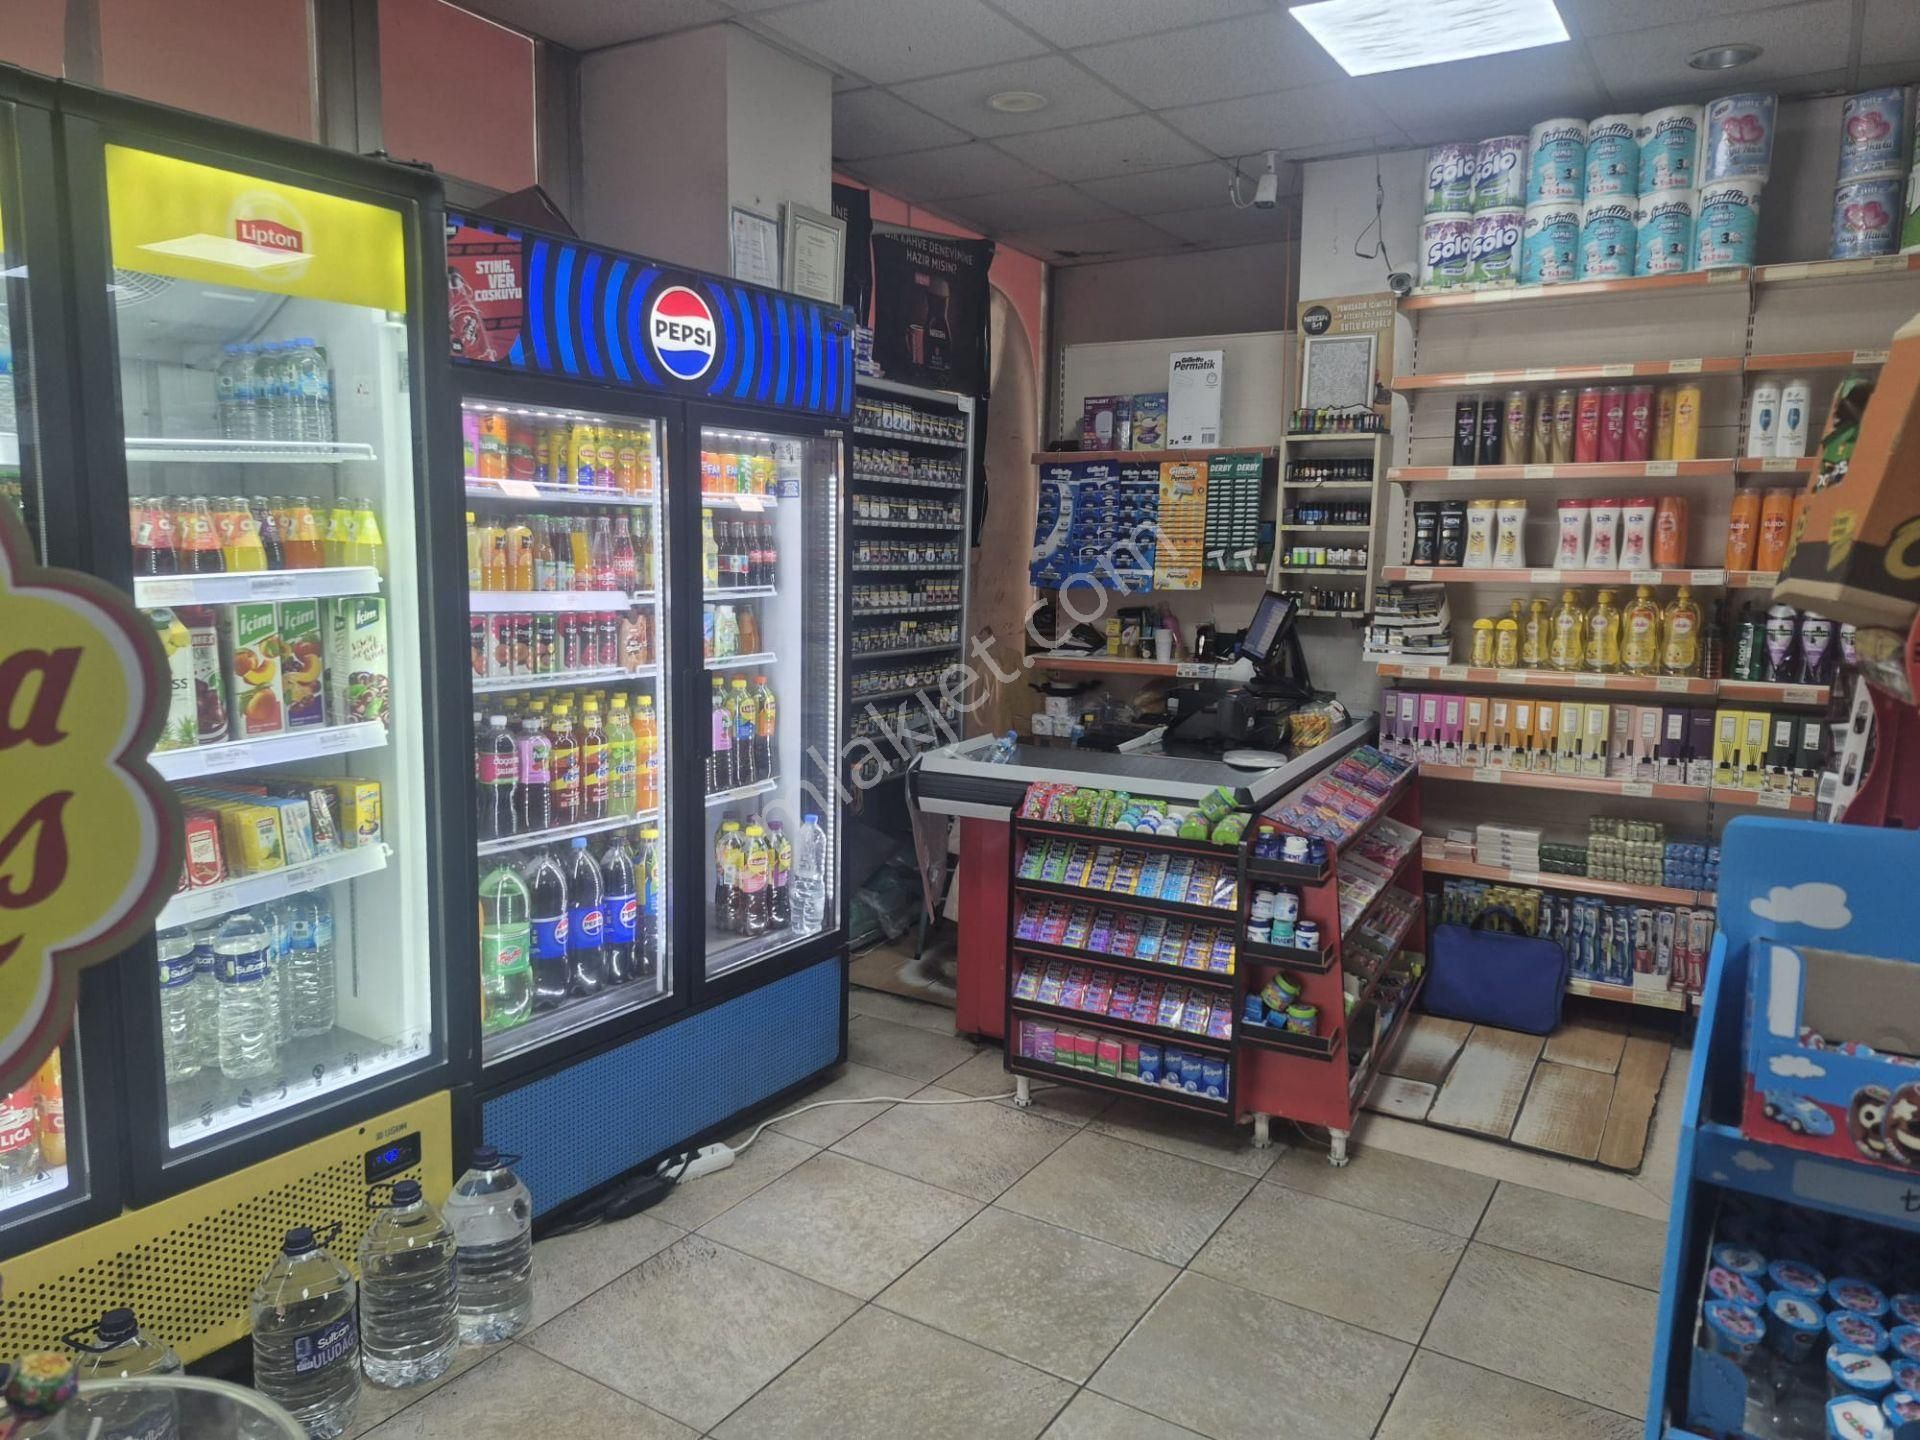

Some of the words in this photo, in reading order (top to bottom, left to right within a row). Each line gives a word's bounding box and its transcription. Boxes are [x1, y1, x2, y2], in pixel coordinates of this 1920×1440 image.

[241, 224, 299, 249] Lipton
[1471, 229, 1518, 262] Solo
[475, 259, 515, 274] STING.
[488, 273, 515, 289] VER
[655, 319, 713, 348] PEPSI
[1173, 360, 1215, 371] Permatik
[1209, 464, 1231, 472] DERBY
[1236, 463, 1260, 472] DERBY
[236, 961, 266, 975] Sultan
[0, 1128, 31, 1146] LICA
[317, 1324, 350, 1349] Sultan
